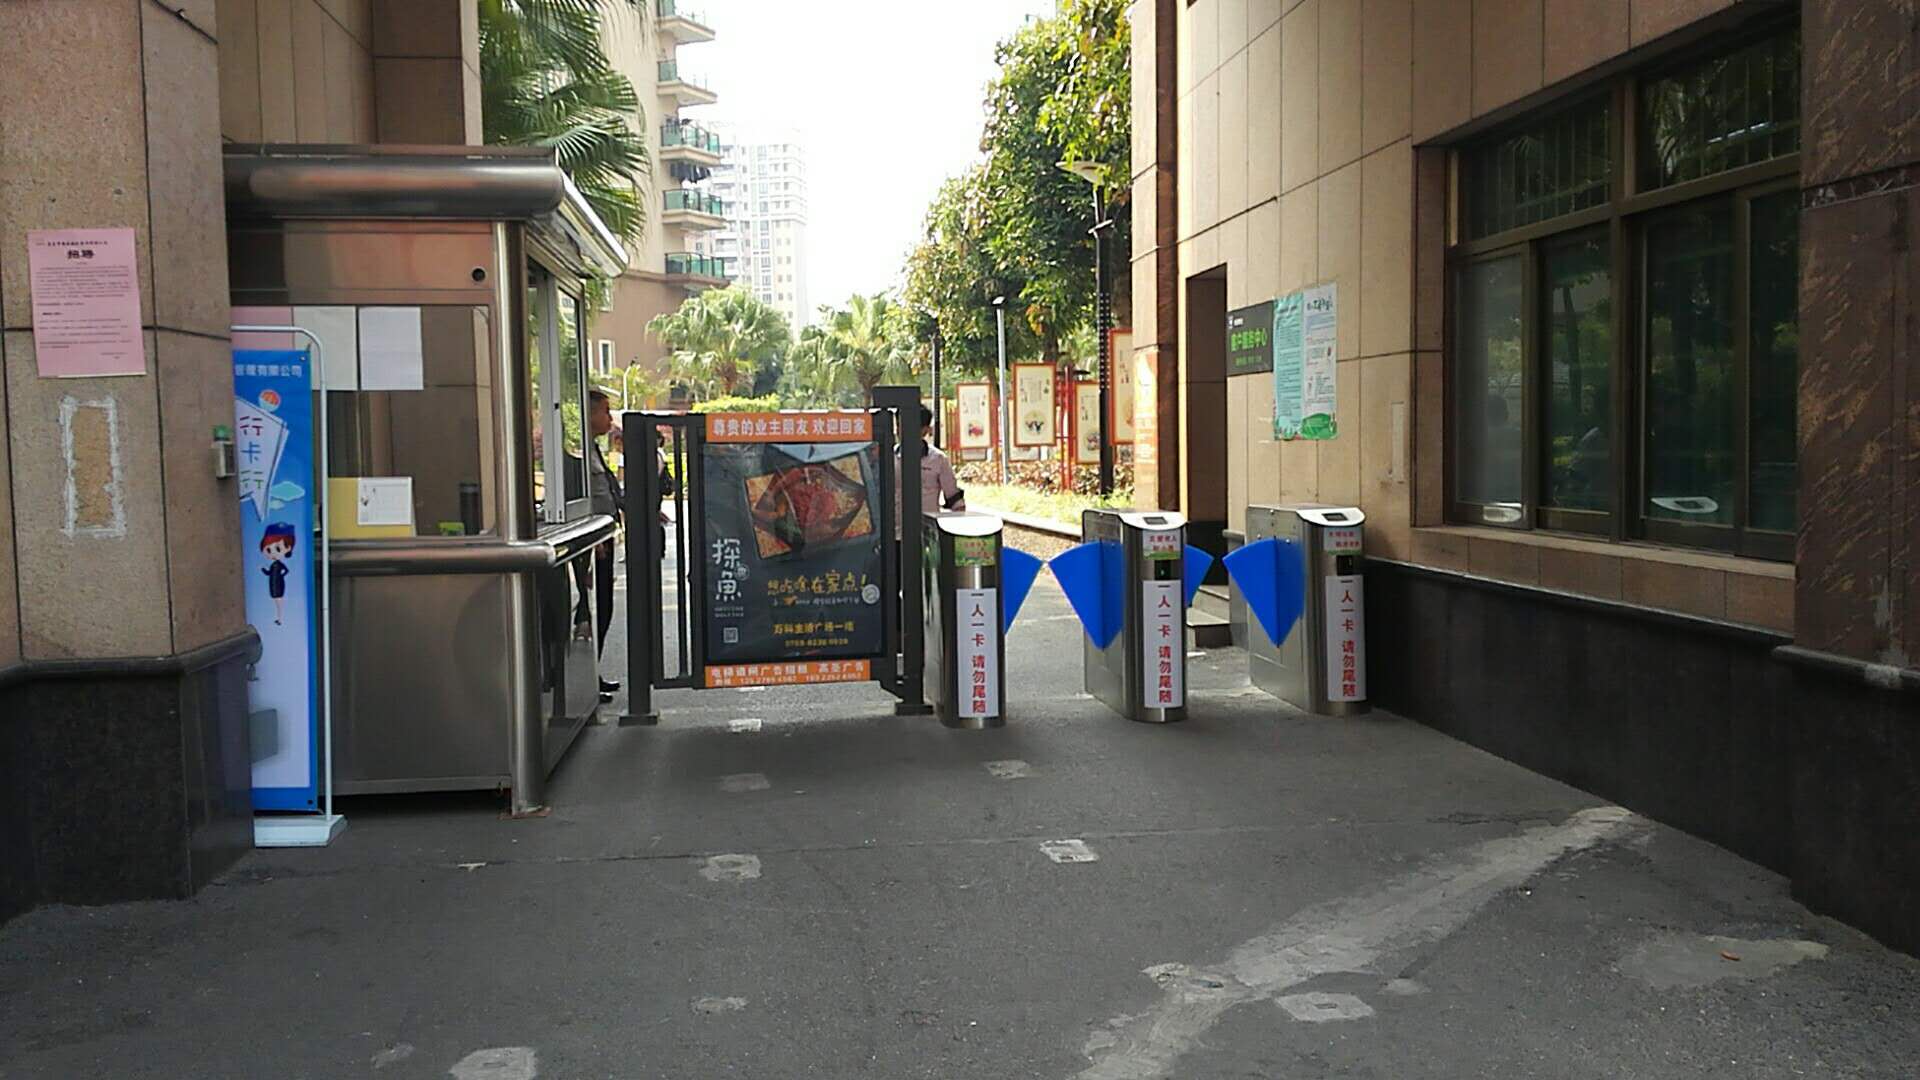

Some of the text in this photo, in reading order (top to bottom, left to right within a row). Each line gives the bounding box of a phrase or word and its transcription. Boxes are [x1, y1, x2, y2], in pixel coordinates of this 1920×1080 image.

[67, 249, 94, 260] 招聘
[713, 418, 866, 436] 尊贵的业主朋友 欢迎回家
[971, 592, 986, 713] 一人一卡 请勿尾随
[1157, 584, 1172, 703] 一人一卡 请勿尾随
[1341, 579, 1356, 697] 一人一卡 请勿尾随
